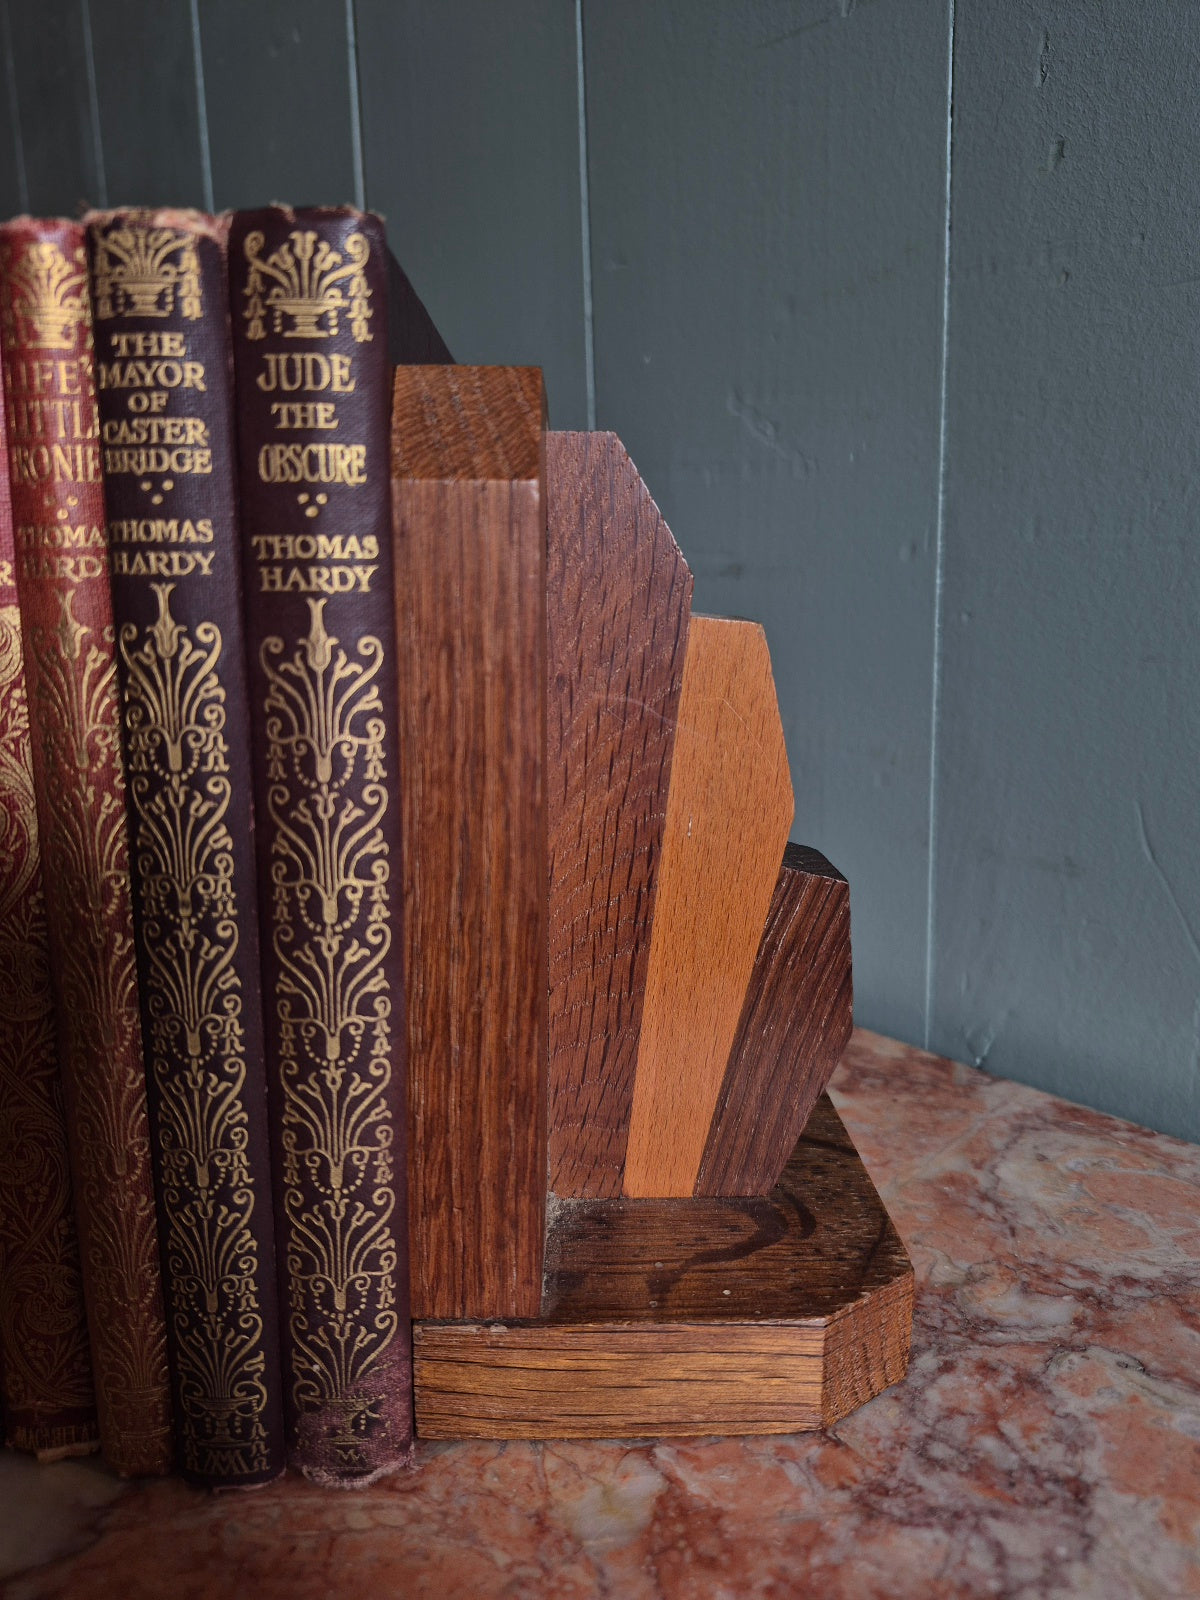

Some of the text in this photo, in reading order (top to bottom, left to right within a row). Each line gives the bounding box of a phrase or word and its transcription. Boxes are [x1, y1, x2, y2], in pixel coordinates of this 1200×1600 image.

[111, 331, 186, 357] THE
[98, 360, 207, 392] MAYOR
[256, 352, 357, 392] JUDE
[127, 390, 169, 413] OF
[270, 402, 340, 429] THE
[105, 447, 213, 476] BRIDGE
[258, 443, 368, 486] OBSCURE
[17, 525, 108, 549] THOMA
[110, 518, 214, 544] THOMAS
[252, 534, 380, 560] THOMAS
[22, 554, 107, 583] HARD
[113, 550, 216, 577] HARDY
[259, 564, 380, 594] HARDY
